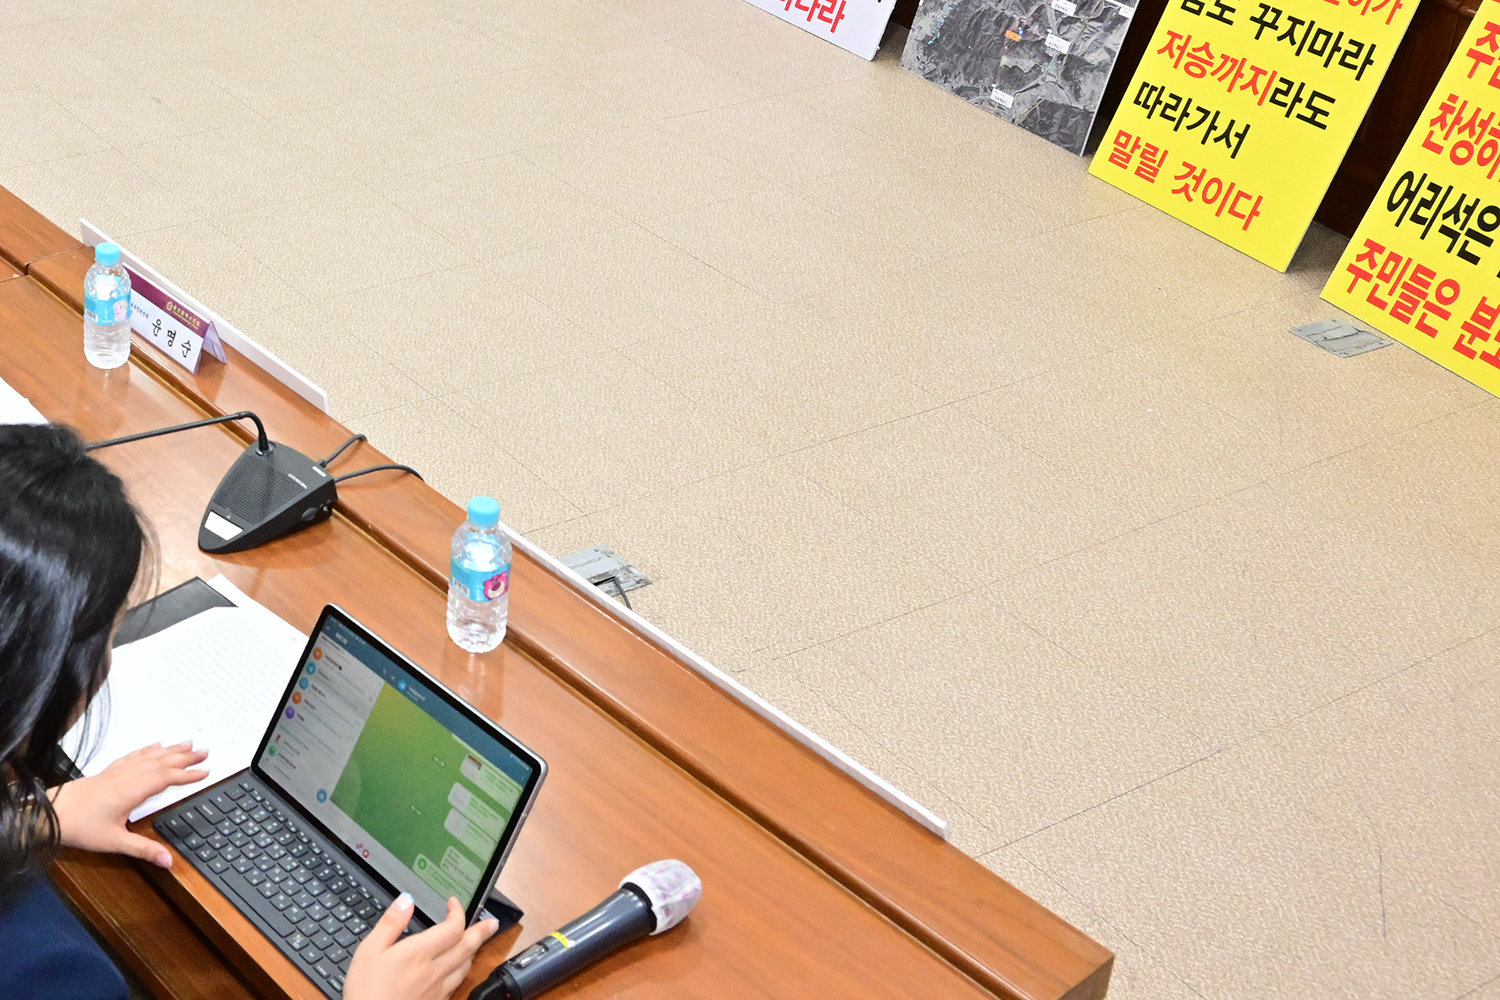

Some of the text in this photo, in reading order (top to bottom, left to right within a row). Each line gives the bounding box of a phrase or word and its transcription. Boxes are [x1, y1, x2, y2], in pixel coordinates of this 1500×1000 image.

[1157, 30, 1336, 130] 저승까지라도
[1249, 2, 1377, 81] 꾸지마라
[1133, 81, 1251, 159] 따라가서
[1108, 129, 1264, 231] 말릴 것이다
[1387, 170, 1500, 265] 어리석은
[1346, 238, 1461, 339] 주민들은
[152, 318, 193, 359] 윤명순
